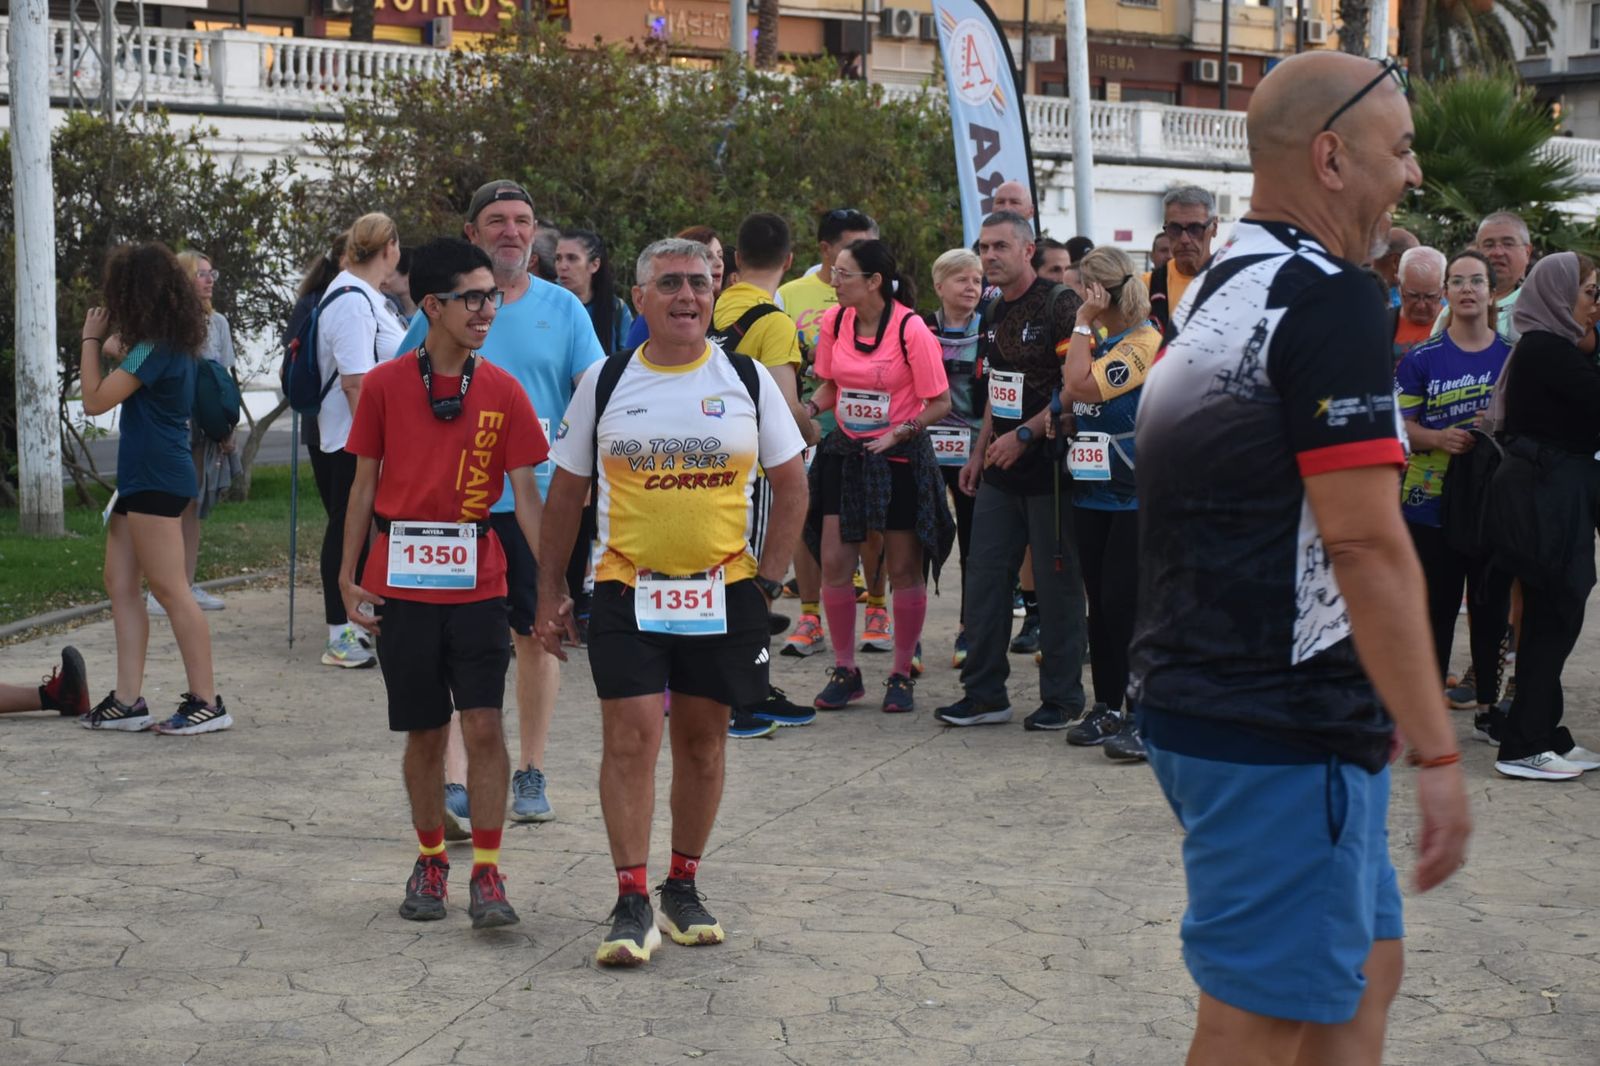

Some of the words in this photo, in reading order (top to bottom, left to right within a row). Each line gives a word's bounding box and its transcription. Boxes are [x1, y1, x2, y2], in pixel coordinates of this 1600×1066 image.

[845, 403, 882, 419] 1323
[610, 439, 642, 456] NO
[649, 436, 721, 454] TODO
[1071, 448, 1103, 463] 1336
[627, 454, 656, 472] VA
[661, 454, 675, 470] A
[682, 453, 730, 470] SER
[644, 470, 739, 490] CORRER!
[403, 544, 468, 565] 1350
[650, 589, 713, 610] 1351
